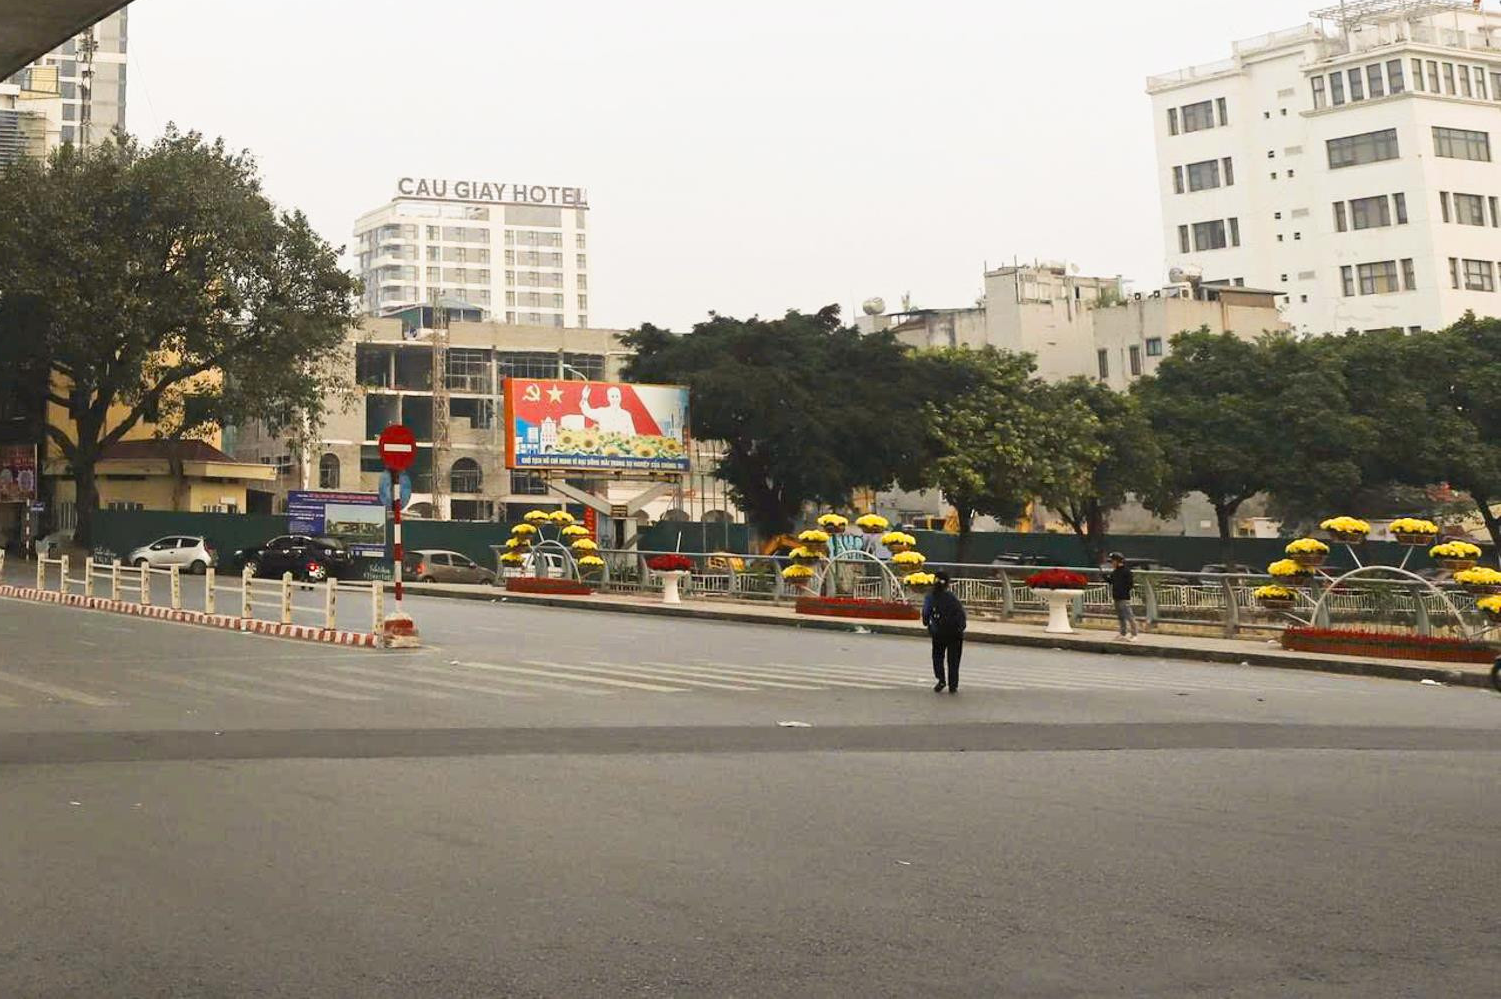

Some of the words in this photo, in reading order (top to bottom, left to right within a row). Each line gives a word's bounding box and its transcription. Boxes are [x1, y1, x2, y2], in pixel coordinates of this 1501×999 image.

[398, 177, 448, 197] CAU
[454, 181, 506, 200] GIAY
[513, 184, 588, 206] HOTEL
